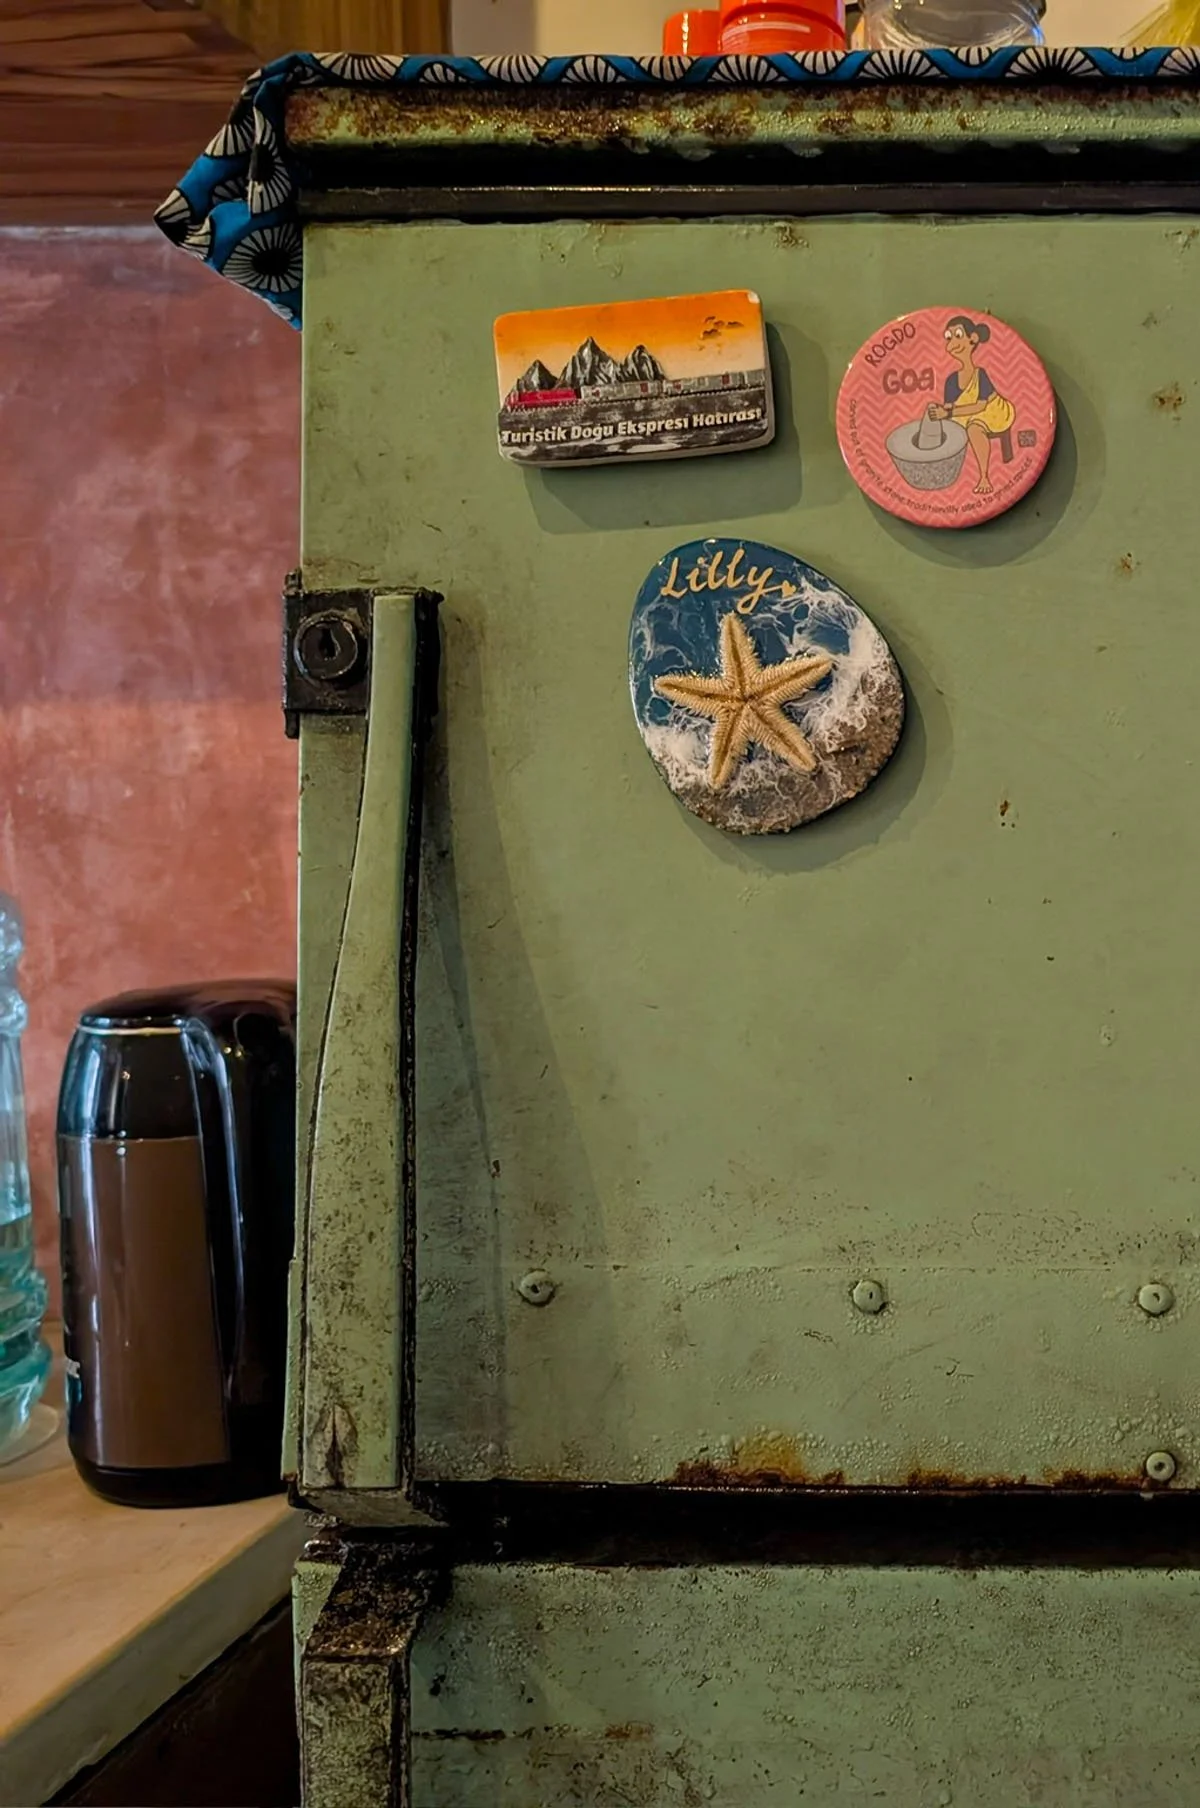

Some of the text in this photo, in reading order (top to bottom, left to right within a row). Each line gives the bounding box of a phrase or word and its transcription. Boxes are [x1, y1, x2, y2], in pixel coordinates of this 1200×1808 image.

[864, 322, 917, 368] ROGDO
[501, 425, 568, 444] Turistik
[660, 548, 784, 615] Lilly
